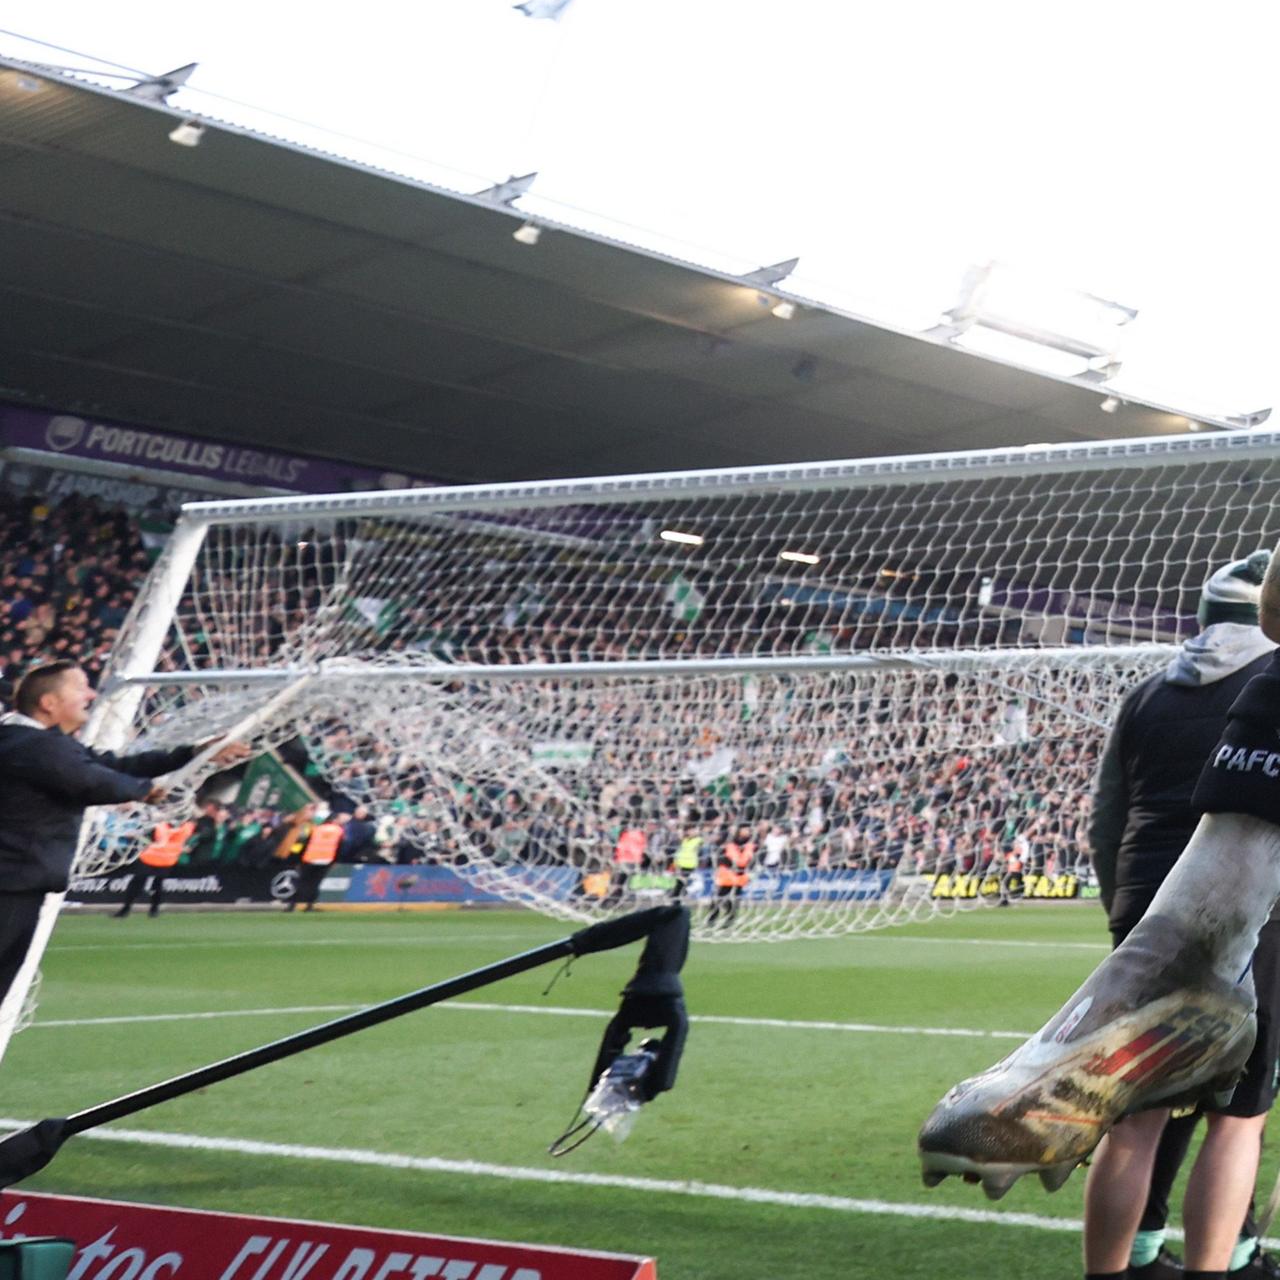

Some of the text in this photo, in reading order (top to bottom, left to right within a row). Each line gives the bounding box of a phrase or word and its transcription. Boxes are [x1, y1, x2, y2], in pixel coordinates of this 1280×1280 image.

[85, 425, 301, 483] PORTCULLIS LEGALS
[1023, 874, 1077, 898] TAXI
